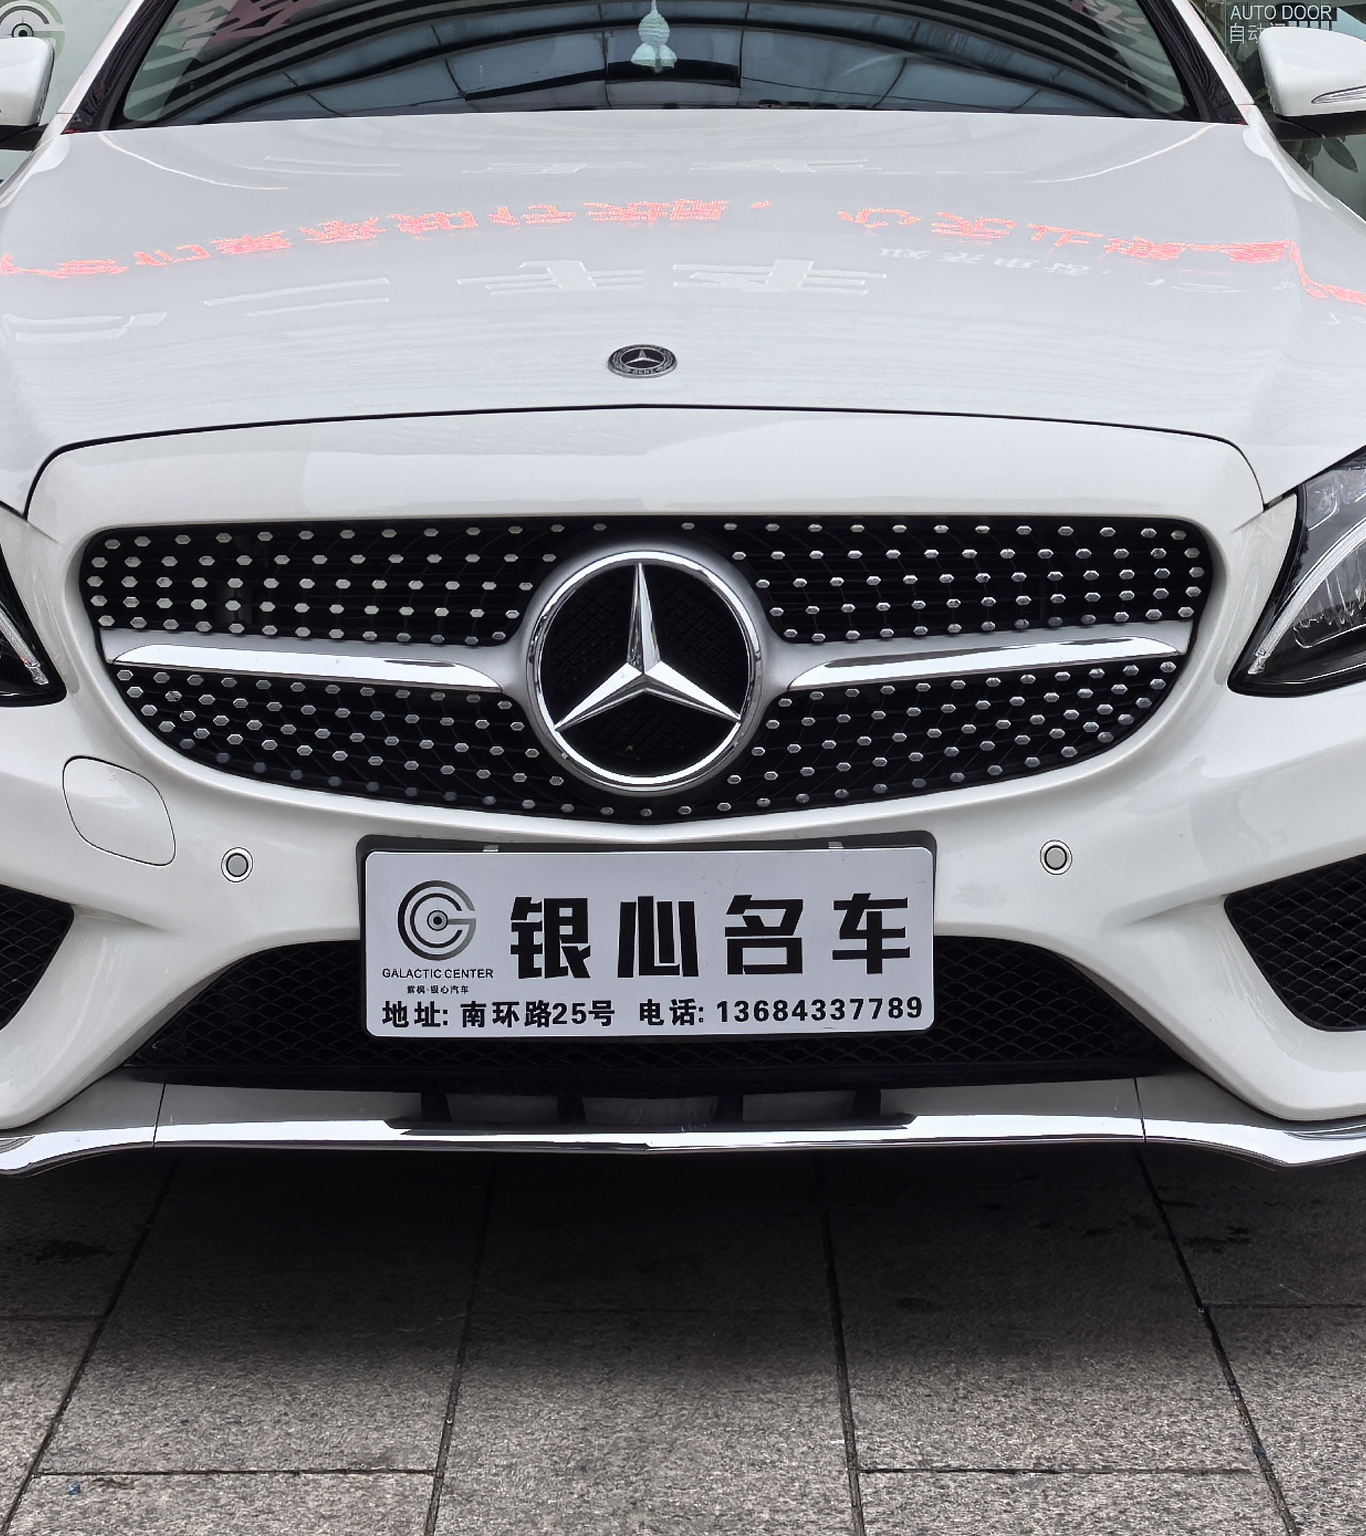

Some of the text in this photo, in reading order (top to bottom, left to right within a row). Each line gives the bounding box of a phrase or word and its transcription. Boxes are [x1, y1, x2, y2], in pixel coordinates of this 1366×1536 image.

[1230, 4, 1332, 20] AUTO DOOR
[1230, 22, 1285, 44] 自动
[510, 892, 910, 980] 银心名车
[382, 968, 494, 979] GALACTIC CENTER
